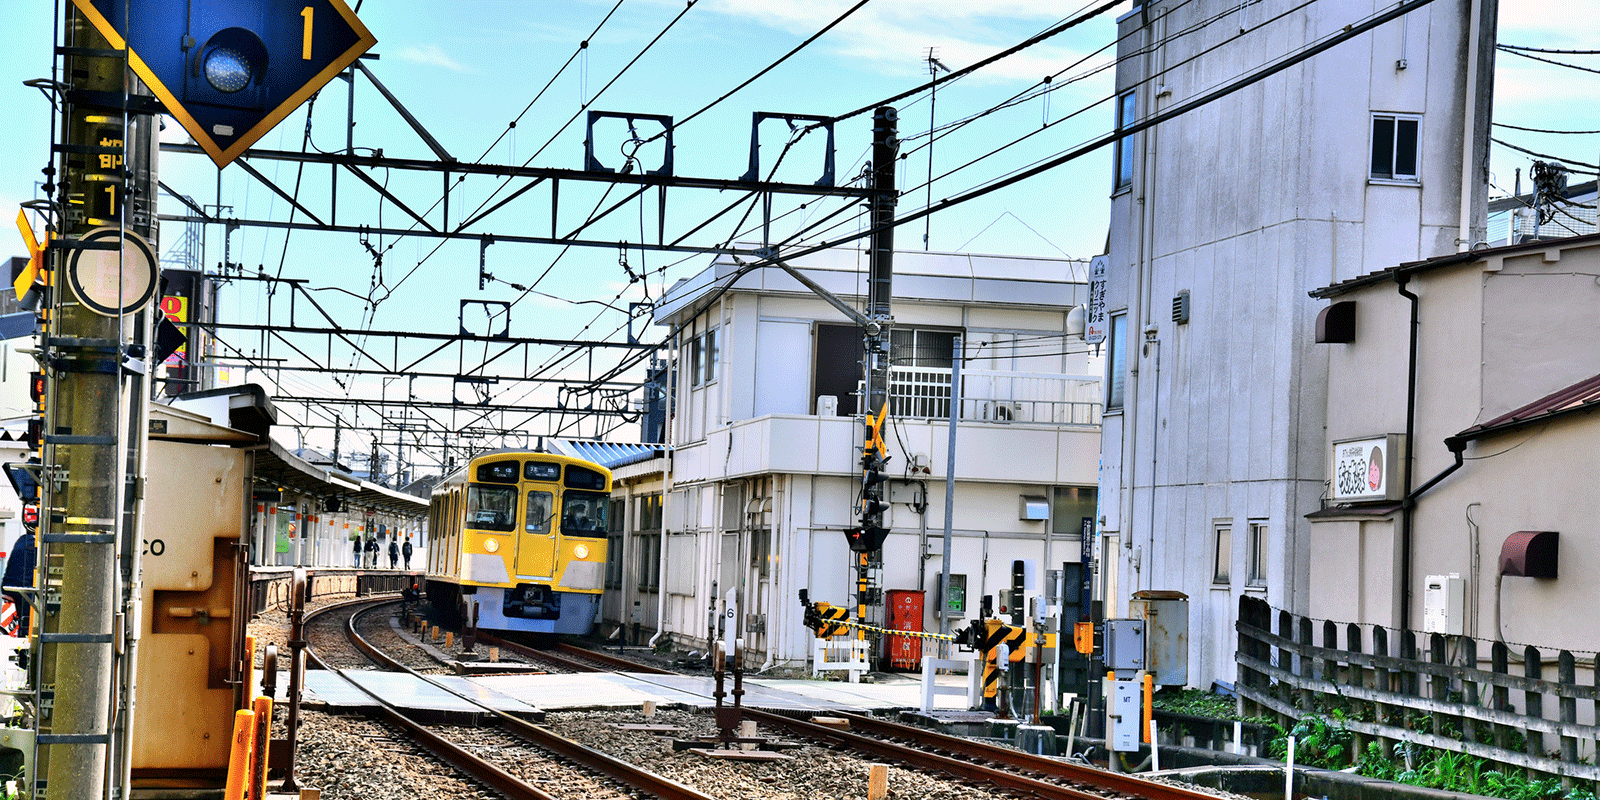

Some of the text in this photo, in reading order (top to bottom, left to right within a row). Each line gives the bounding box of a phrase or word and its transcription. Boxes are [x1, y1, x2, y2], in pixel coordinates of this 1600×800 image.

[300, 6, 314, 61] 1
[104, 184, 116, 216] 1
[1098, 280, 1106, 322] すぎやま
[727, 608, 734, 618] 6
